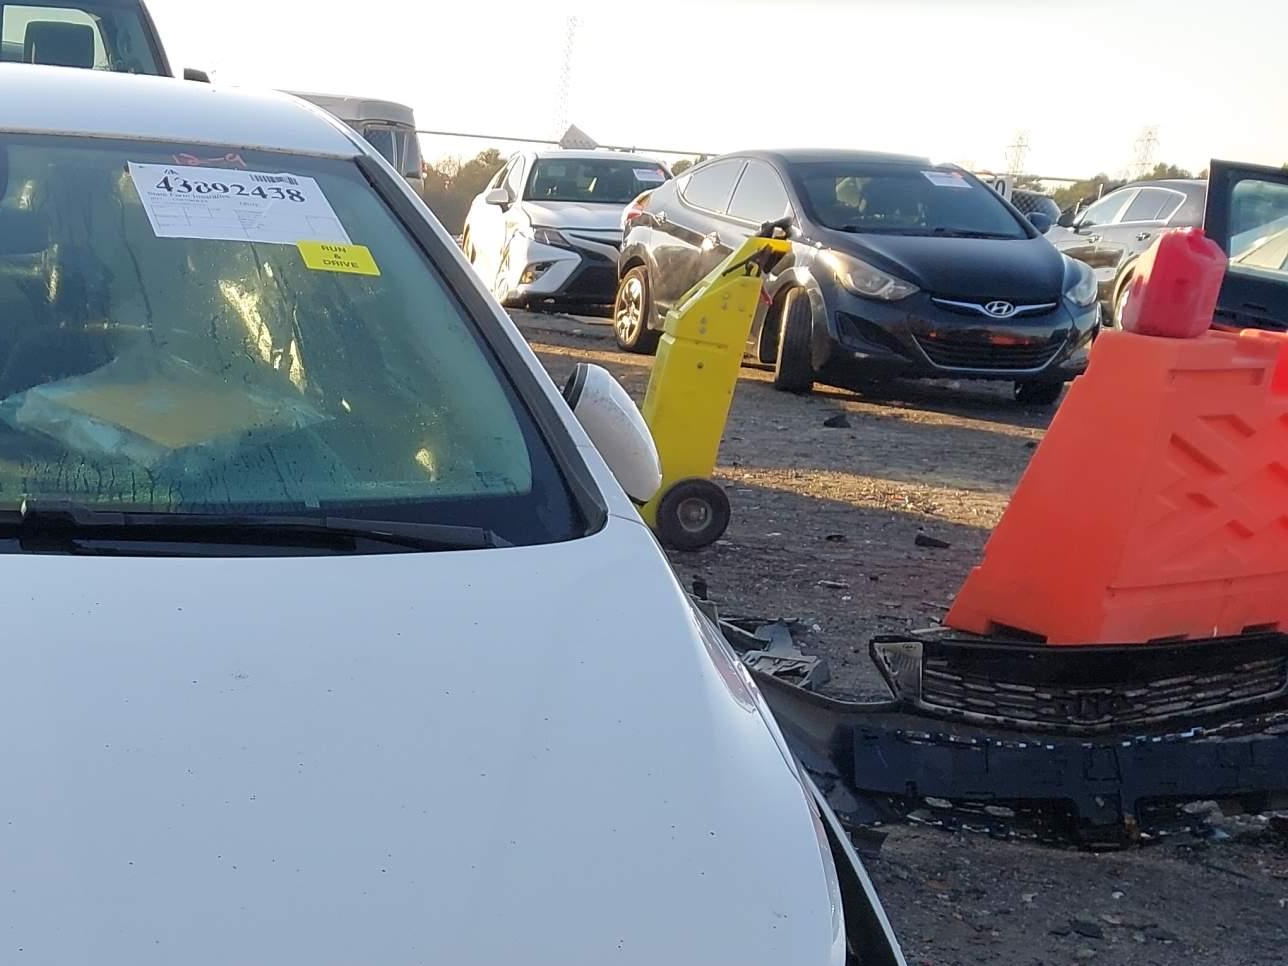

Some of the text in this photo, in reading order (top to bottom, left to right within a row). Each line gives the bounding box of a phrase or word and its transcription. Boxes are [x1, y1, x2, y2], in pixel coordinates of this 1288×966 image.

[156, 175, 306, 203] 43892438
[321, 245, 347, 253] RUN
[323, 259, 360, 269] DRIVE
